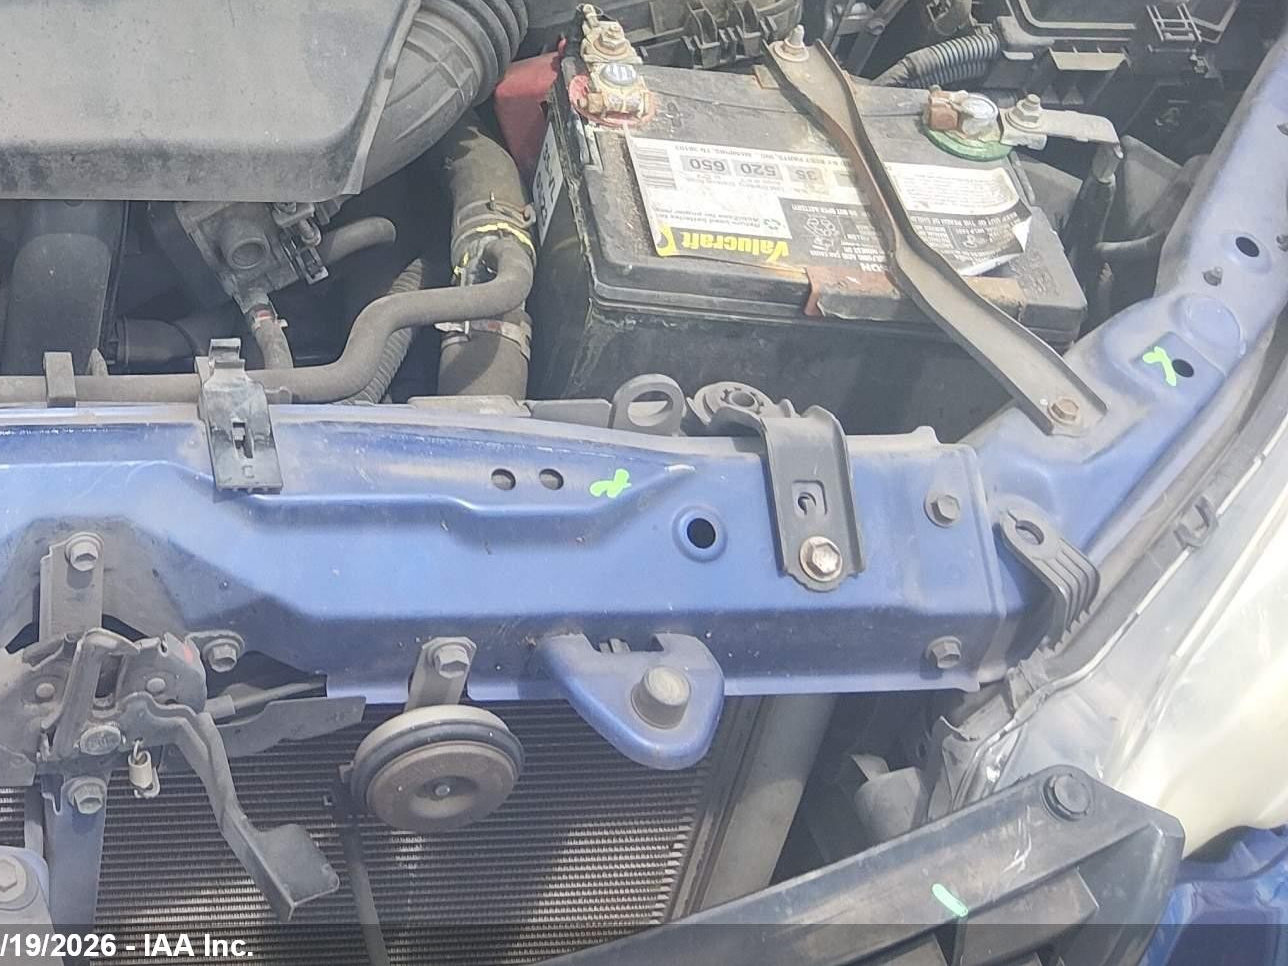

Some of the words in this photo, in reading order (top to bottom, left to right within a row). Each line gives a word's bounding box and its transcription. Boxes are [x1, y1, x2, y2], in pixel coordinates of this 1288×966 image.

[689, 158, 725, 172] 650
[740, 163, 776, 177] 520
[794, 170, 818, 180] 35
[680, 232, 789, 264] Valucraft
